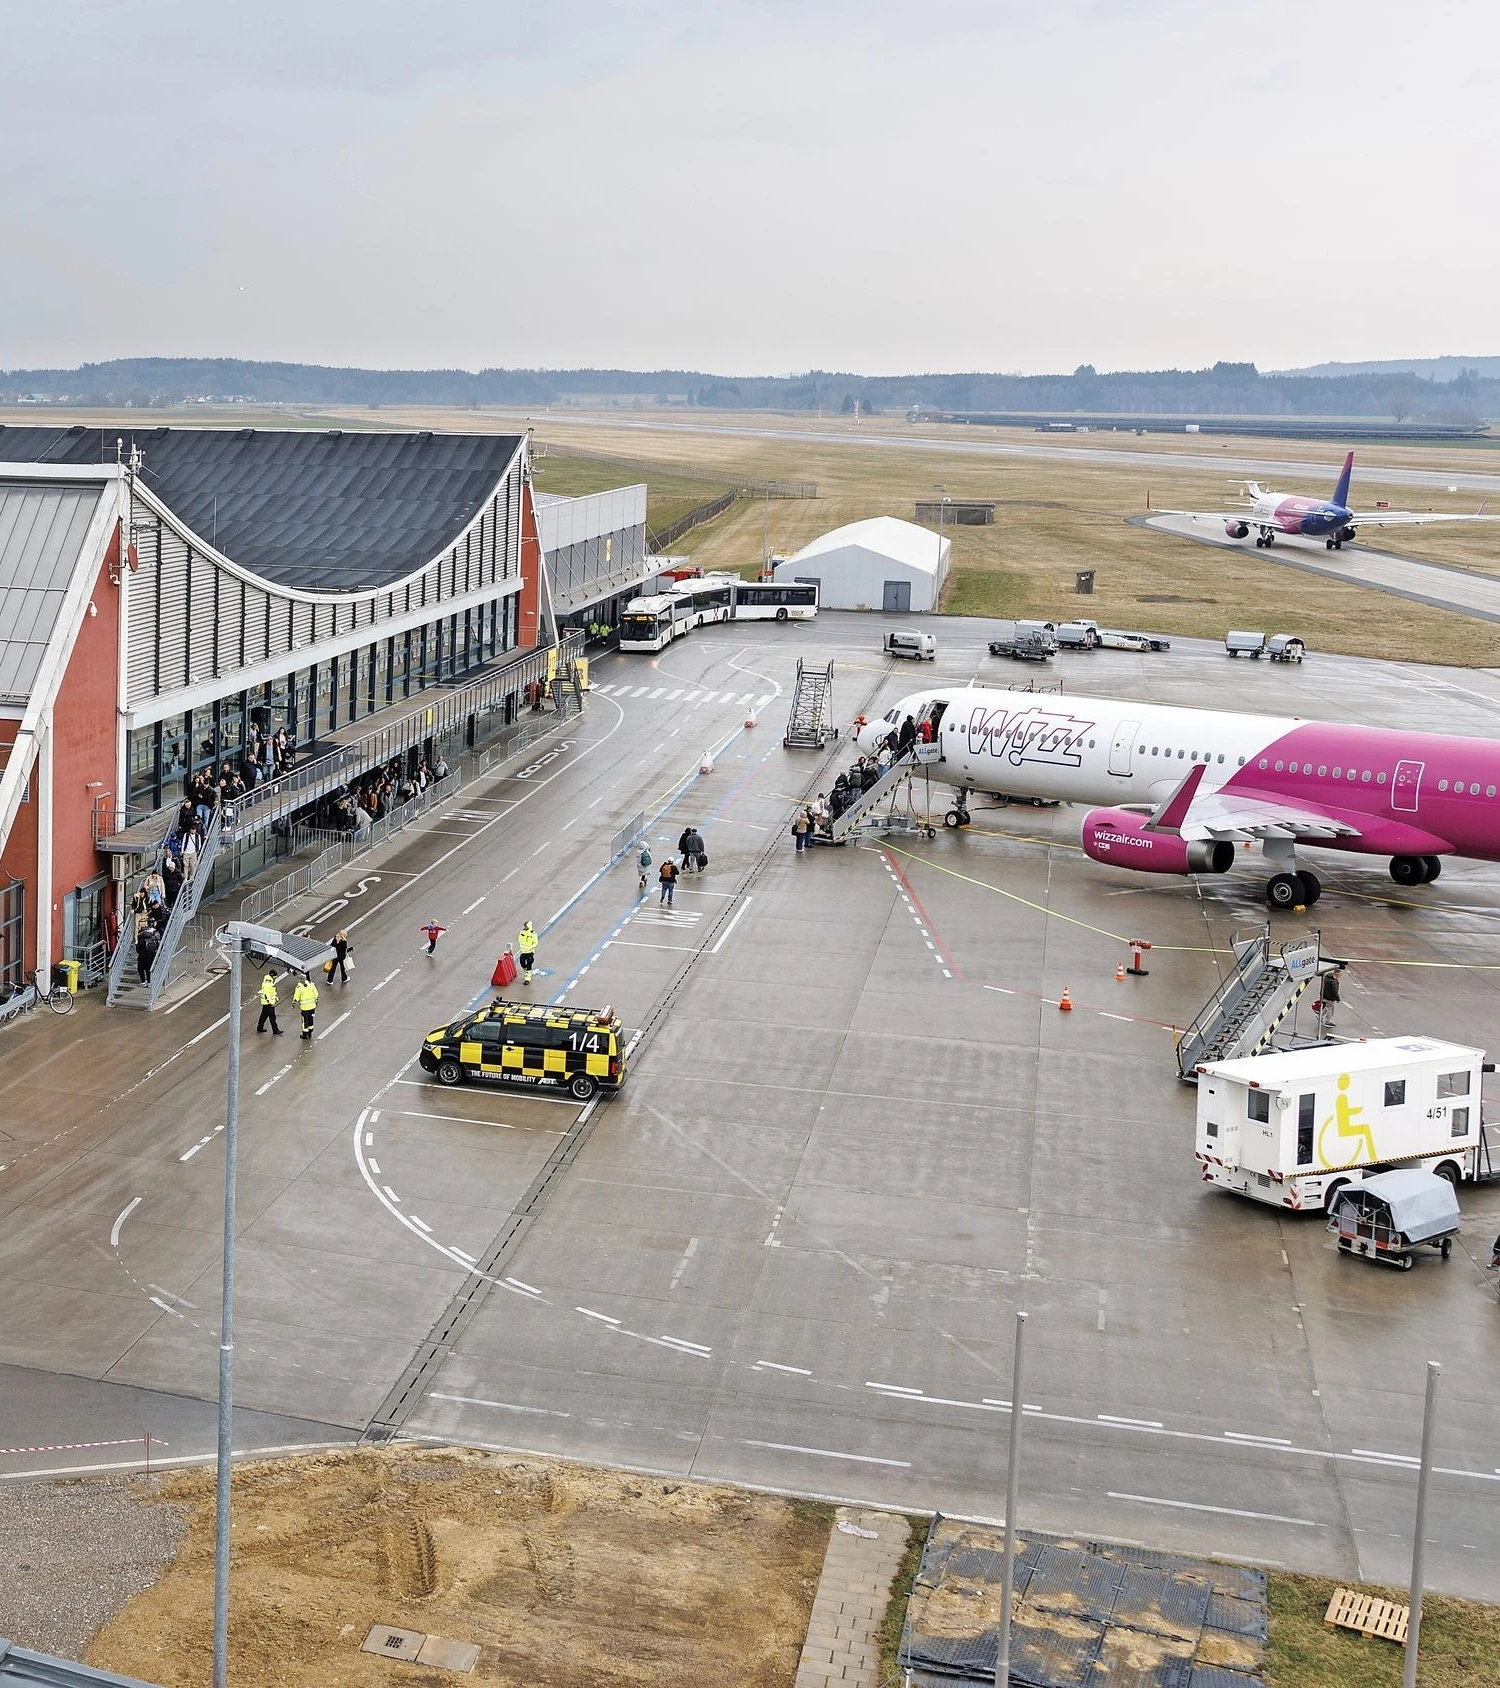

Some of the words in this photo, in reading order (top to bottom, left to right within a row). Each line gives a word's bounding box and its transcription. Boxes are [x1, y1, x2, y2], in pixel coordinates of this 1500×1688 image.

[517, 740, 576, 778] BUS
[1094, 830, 1153, 849] wizzair.com
[568, 1032, 600, 1053] 1/4
[482, 1071, 502, 1080] FUTURE
[511, 1074, 536, 1083] MOBILITY
[1426, 1106, 1447, 1119] 4/51
